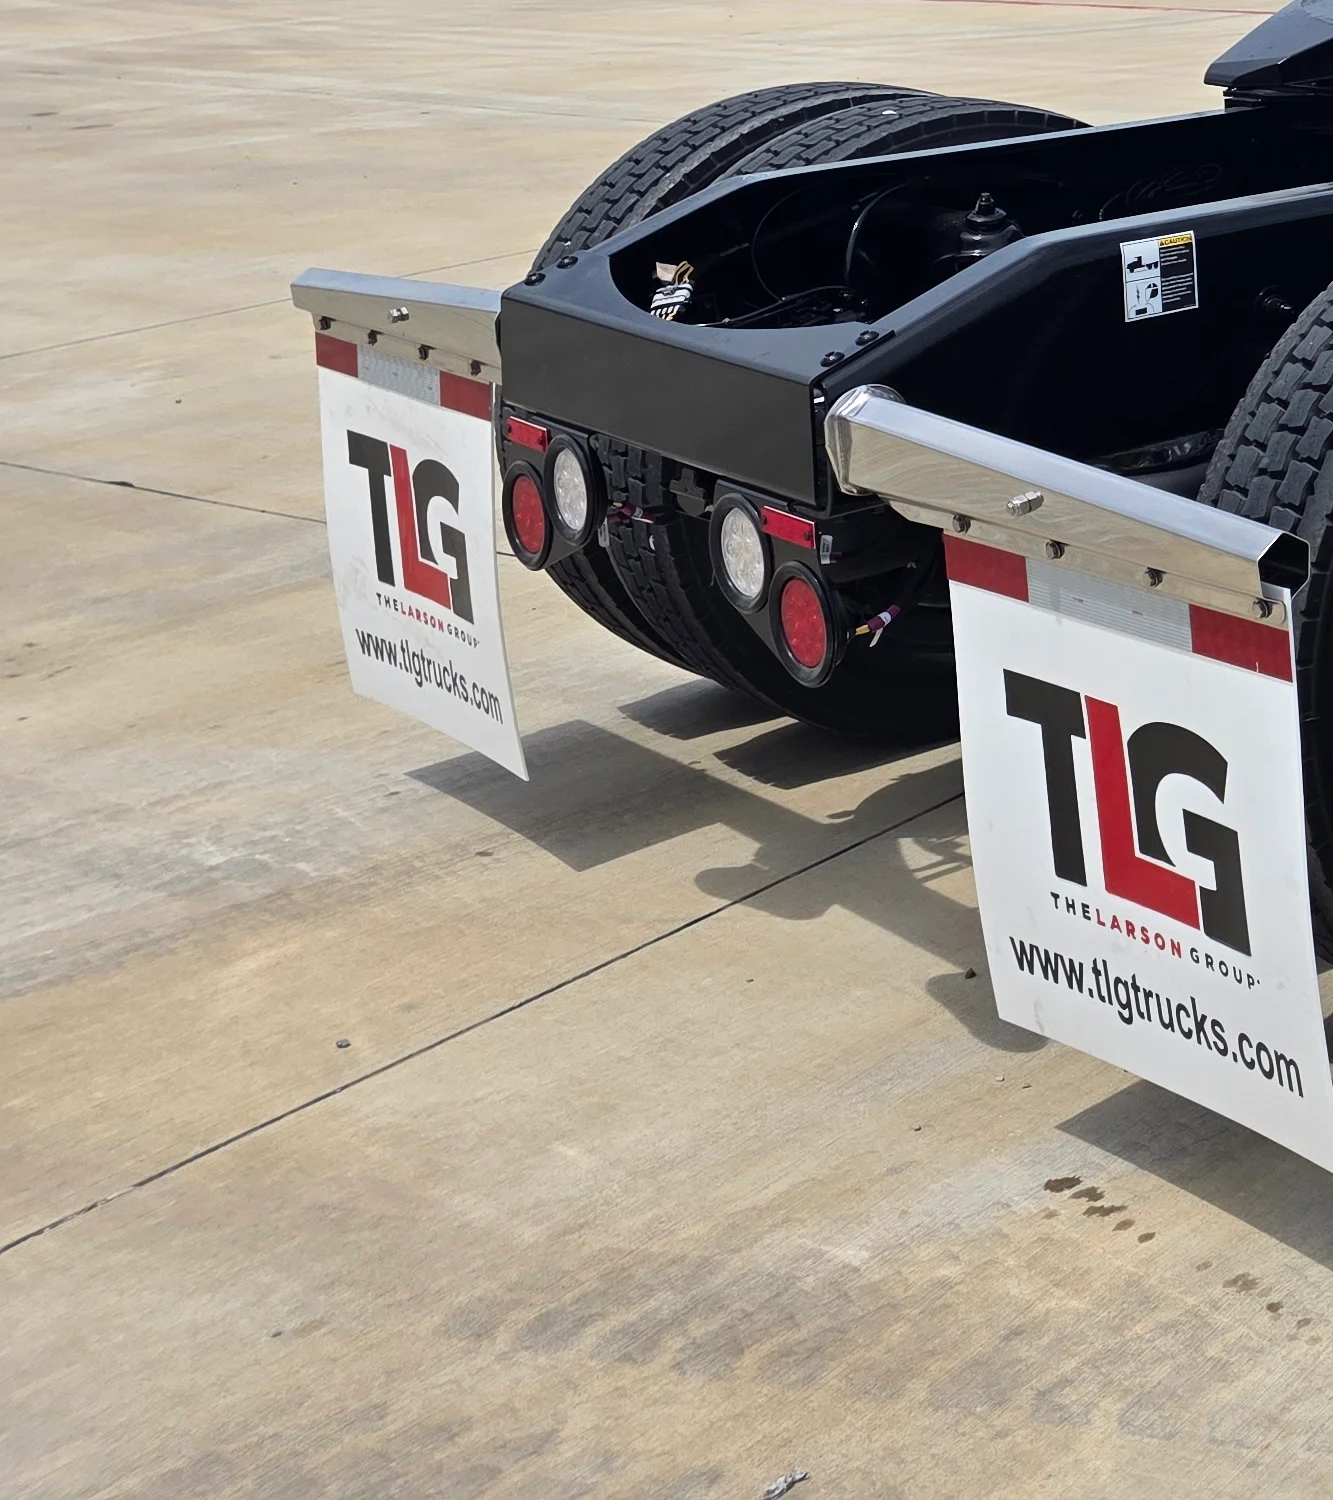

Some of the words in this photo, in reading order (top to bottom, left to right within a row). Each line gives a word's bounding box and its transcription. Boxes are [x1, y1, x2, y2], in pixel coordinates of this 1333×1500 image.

[1164, 236, 1192, 246] CAUTION
[346, 429, 473, 625] TLG
[376, 592, 399, 612] THE
[399, 601, 445, 633] LARSON
[447, 622, 478, 649] GROUP
[354, 627, 504, 725] www.tlgtrucks.com
[1003, 668, 1252, 957] TLG
[1050, 891, 1092, 922] THE
[1095, 908, 1183, 959] LARSON
[1189, 947, 1258, 989] GROUP
[1009, 935, 1304, 1098] www.tlgtrucks.com
